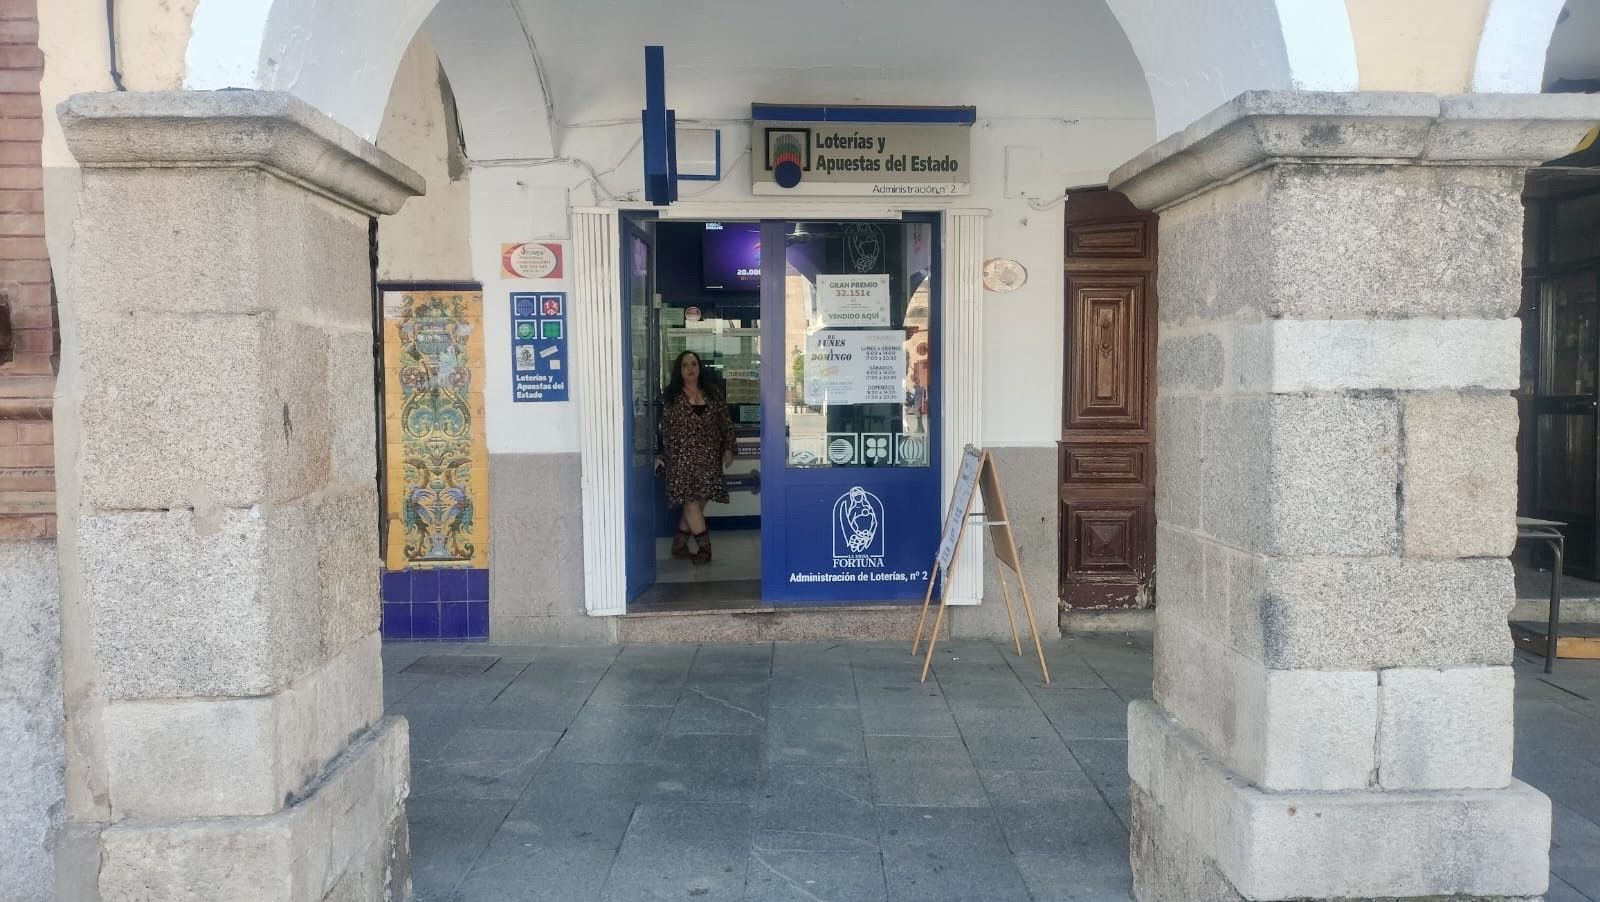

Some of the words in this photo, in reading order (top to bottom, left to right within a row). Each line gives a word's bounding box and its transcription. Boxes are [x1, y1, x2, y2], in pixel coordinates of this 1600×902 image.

[816, 132, 873, 149] Loterías
[877, 136, 885, 154] y
[816, 155, 880, 174] Apuestas
[885, 155, 906, 171] del
[911, 155, 958, 172] Estado
[872, 184, 936, 194] Administración
[950, 185, 956, 193] 2
[861, 312, 880, 320] AQUÍ
[817, 339, 847, 347] LUNES
[811, 353, 852, 361] DOMINGO
[547, 375, 554, 383] y
[516, 383, 552, 392] Apuestas
[552, 382, 565, 390] del
[516, 391, 543, 399] Estado
[832, 558, 885, 568] FORTUNA
[789, 572, 856, 582] Administración
[857, 572, 868, 581] de
[870, 571, 908, 582] Loterías,
[922, 571, 928, 580] 2
